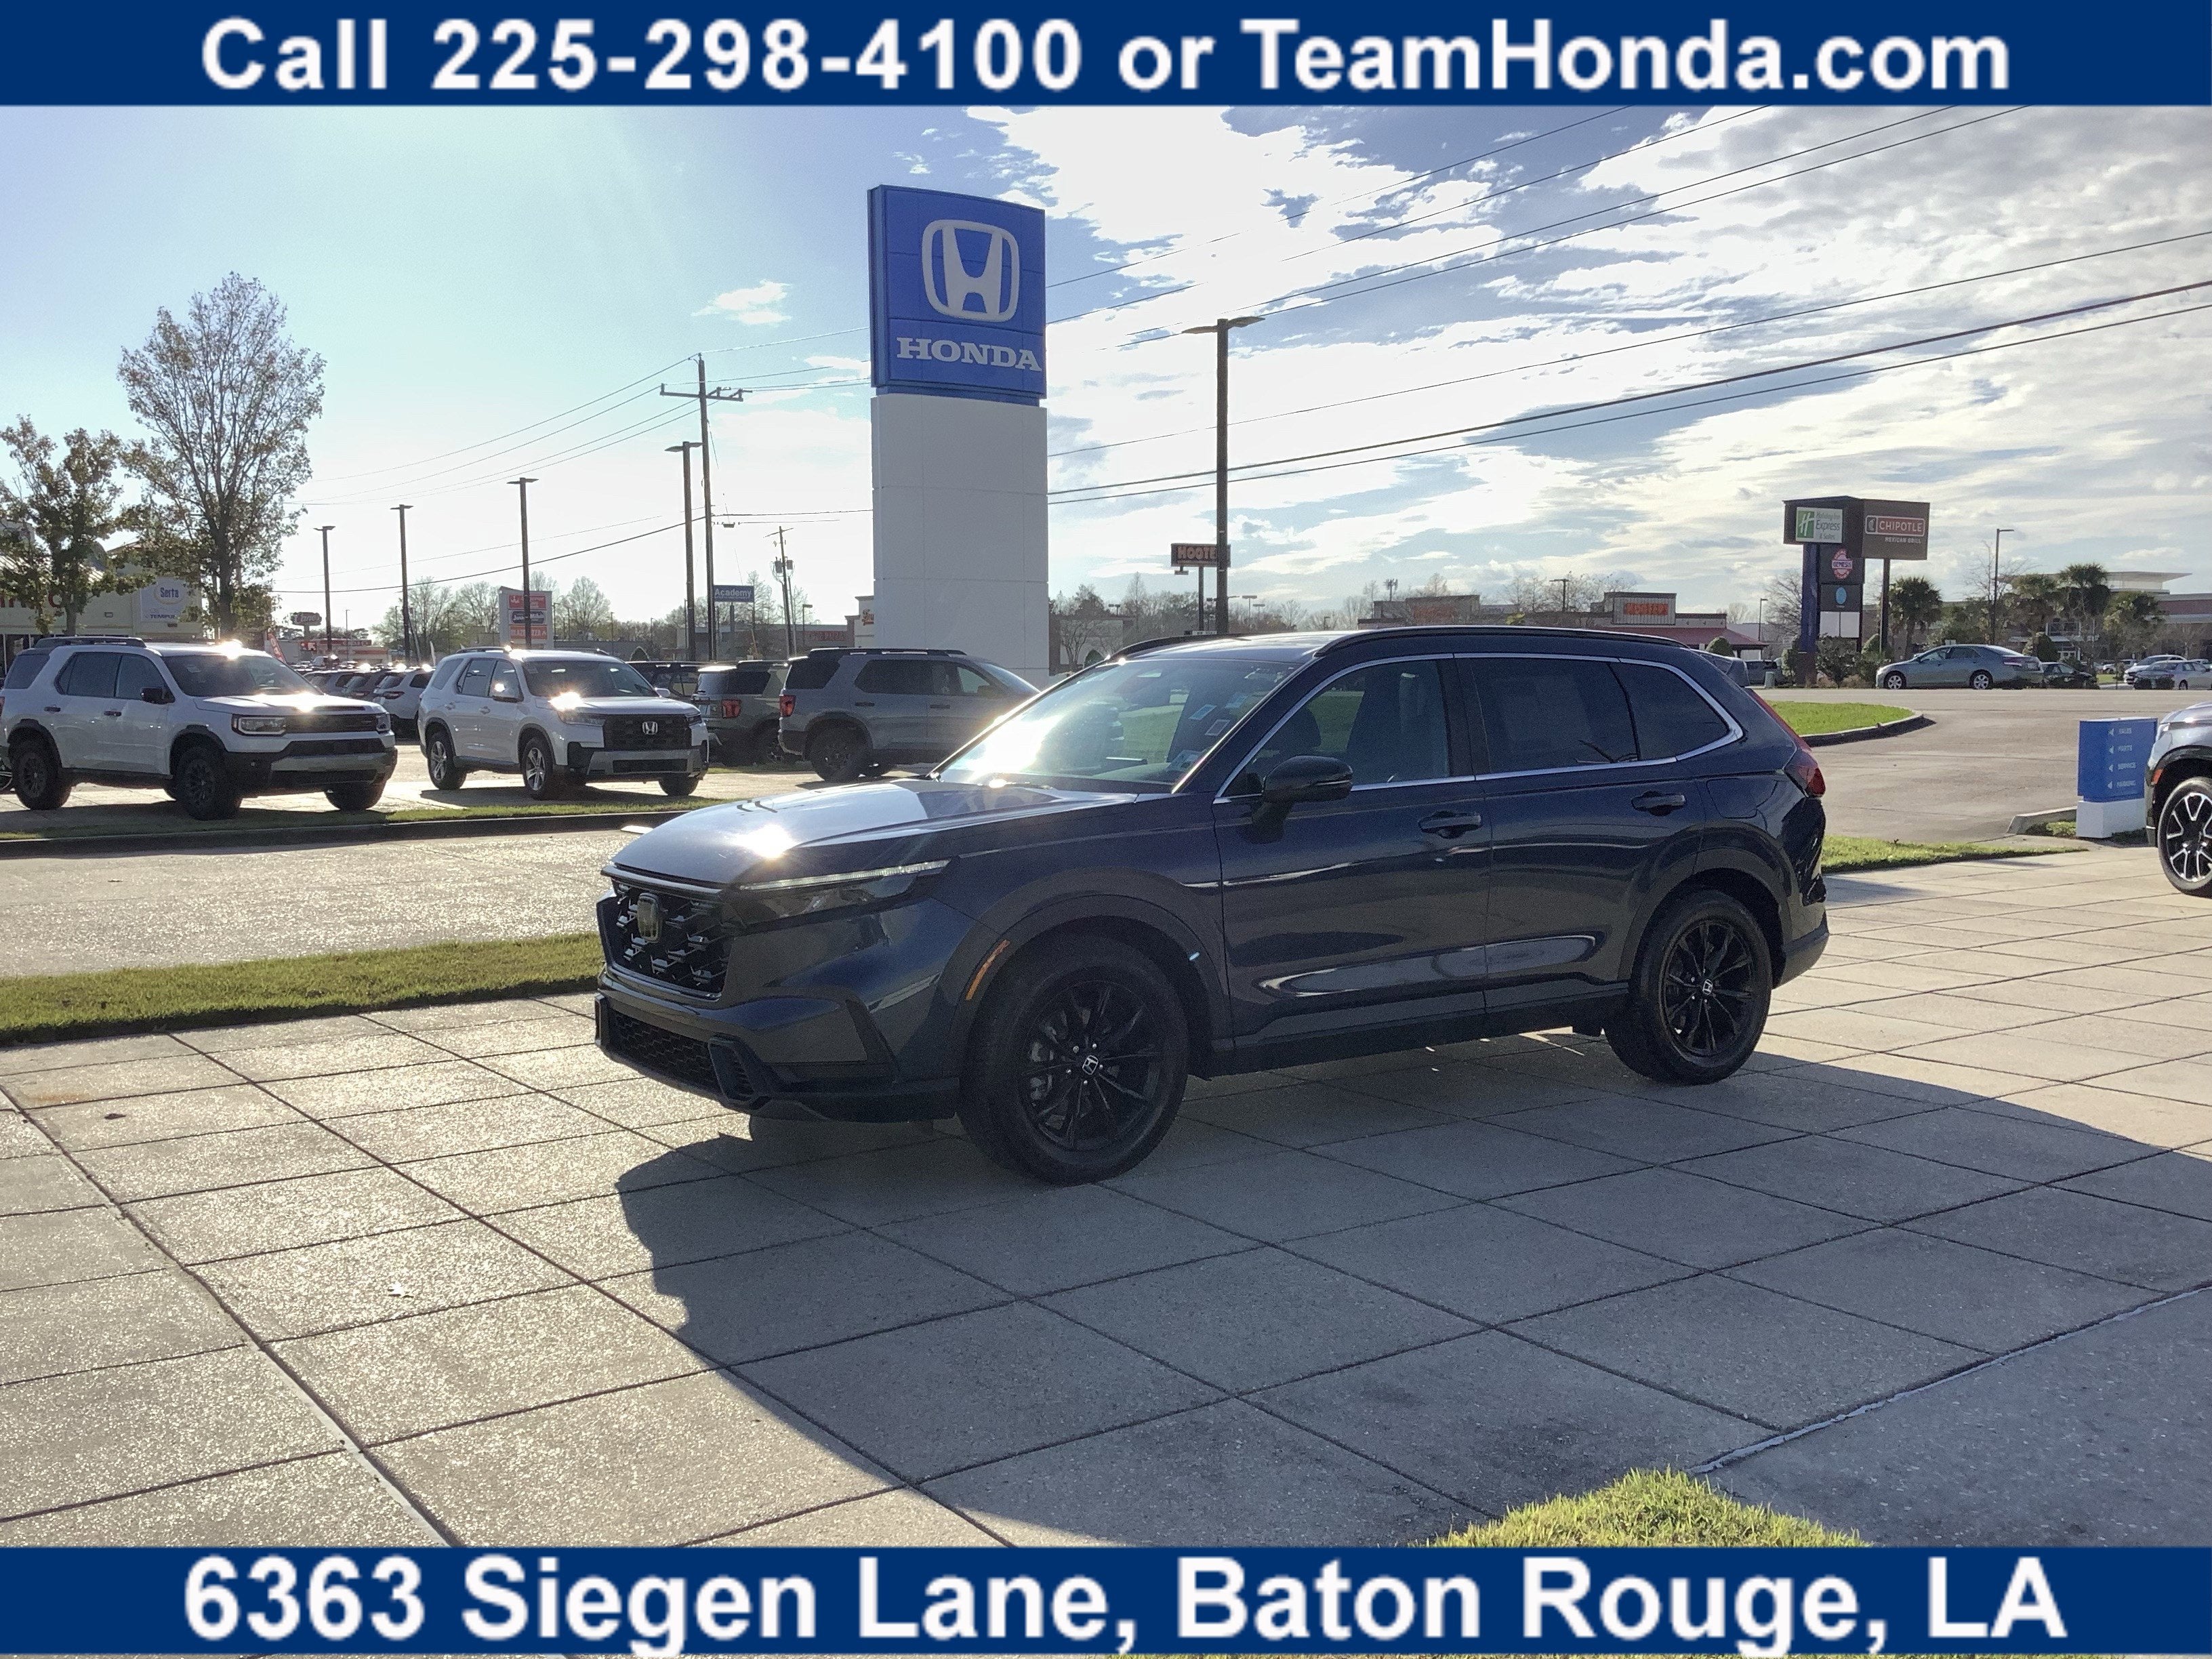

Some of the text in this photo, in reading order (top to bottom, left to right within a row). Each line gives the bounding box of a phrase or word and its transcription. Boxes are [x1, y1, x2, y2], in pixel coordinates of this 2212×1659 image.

[897, 337, 1042, 372] HONDA
[1816, 519, 1840, 532] Express
[1879, 520, 1923, 533] CHIPOTLE
[1177, 546, 1217, 560] HOOTE
[160, 587, 180, 598] Serta
[714, 588, 752, 598] Academy
